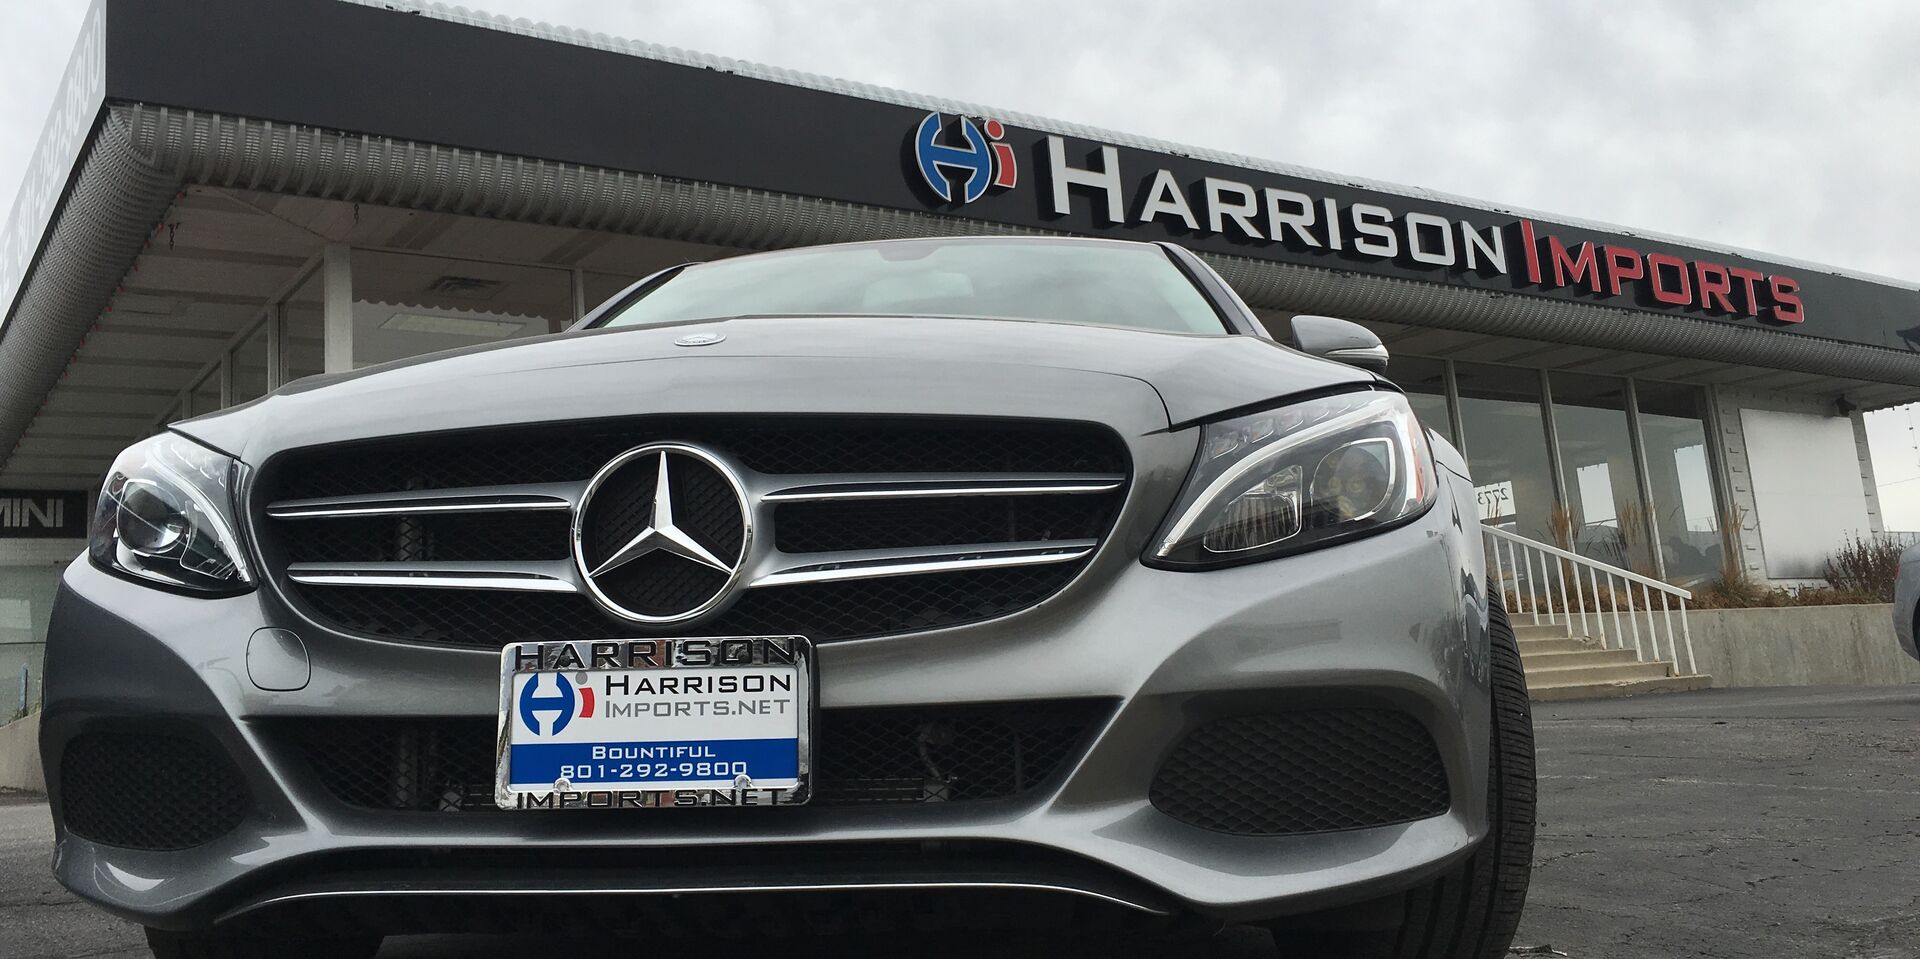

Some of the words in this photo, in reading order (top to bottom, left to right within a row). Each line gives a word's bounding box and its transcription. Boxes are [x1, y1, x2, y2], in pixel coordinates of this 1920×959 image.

[16, 8, 101, 267] 801-292-9800
[1046, 135, 1507, 274] HARRISON
[1519, 219, 1804, 323] IMPORTS
[515, 638, 796, 669] HARRISON
[606, 674, 791, 696] HARRISON
[605, 699, 790, 718] IMPORTS.NET
[592, 745, 716, 760] BOUNTIFUL
[560, 761, 747, 779] 801-292-9800
[517, 788, 787, 809] IMPORTS.NET
